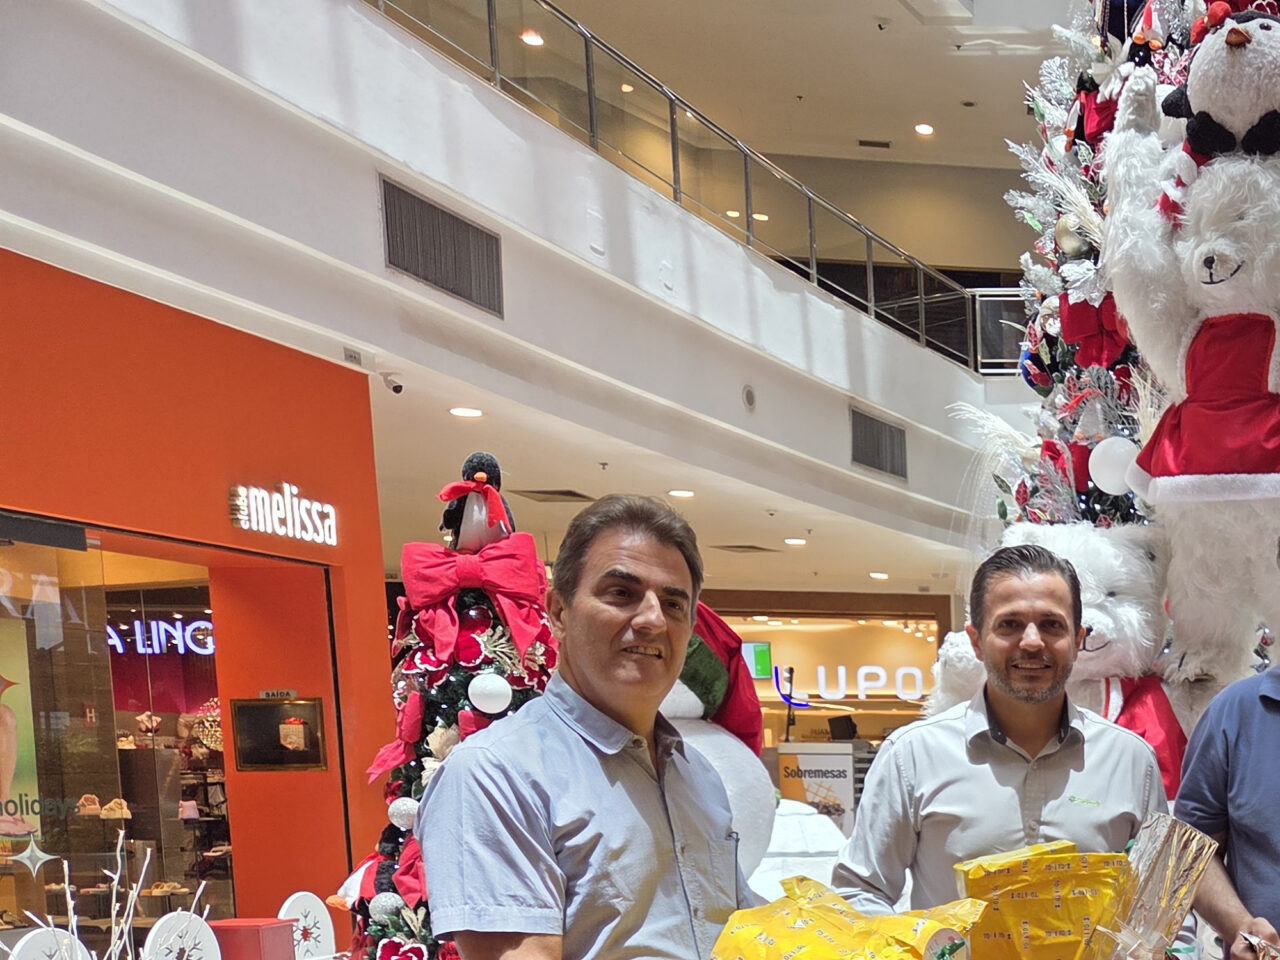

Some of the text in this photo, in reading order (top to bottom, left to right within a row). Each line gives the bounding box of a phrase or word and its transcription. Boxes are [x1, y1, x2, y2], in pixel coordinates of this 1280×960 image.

[249, 481, 338, 546] melissa
[265, 690, 292, 699] SAÍDA
[782, 665, 924, 701] LUPO
[783, 766, 848, 779] Sobremesas
